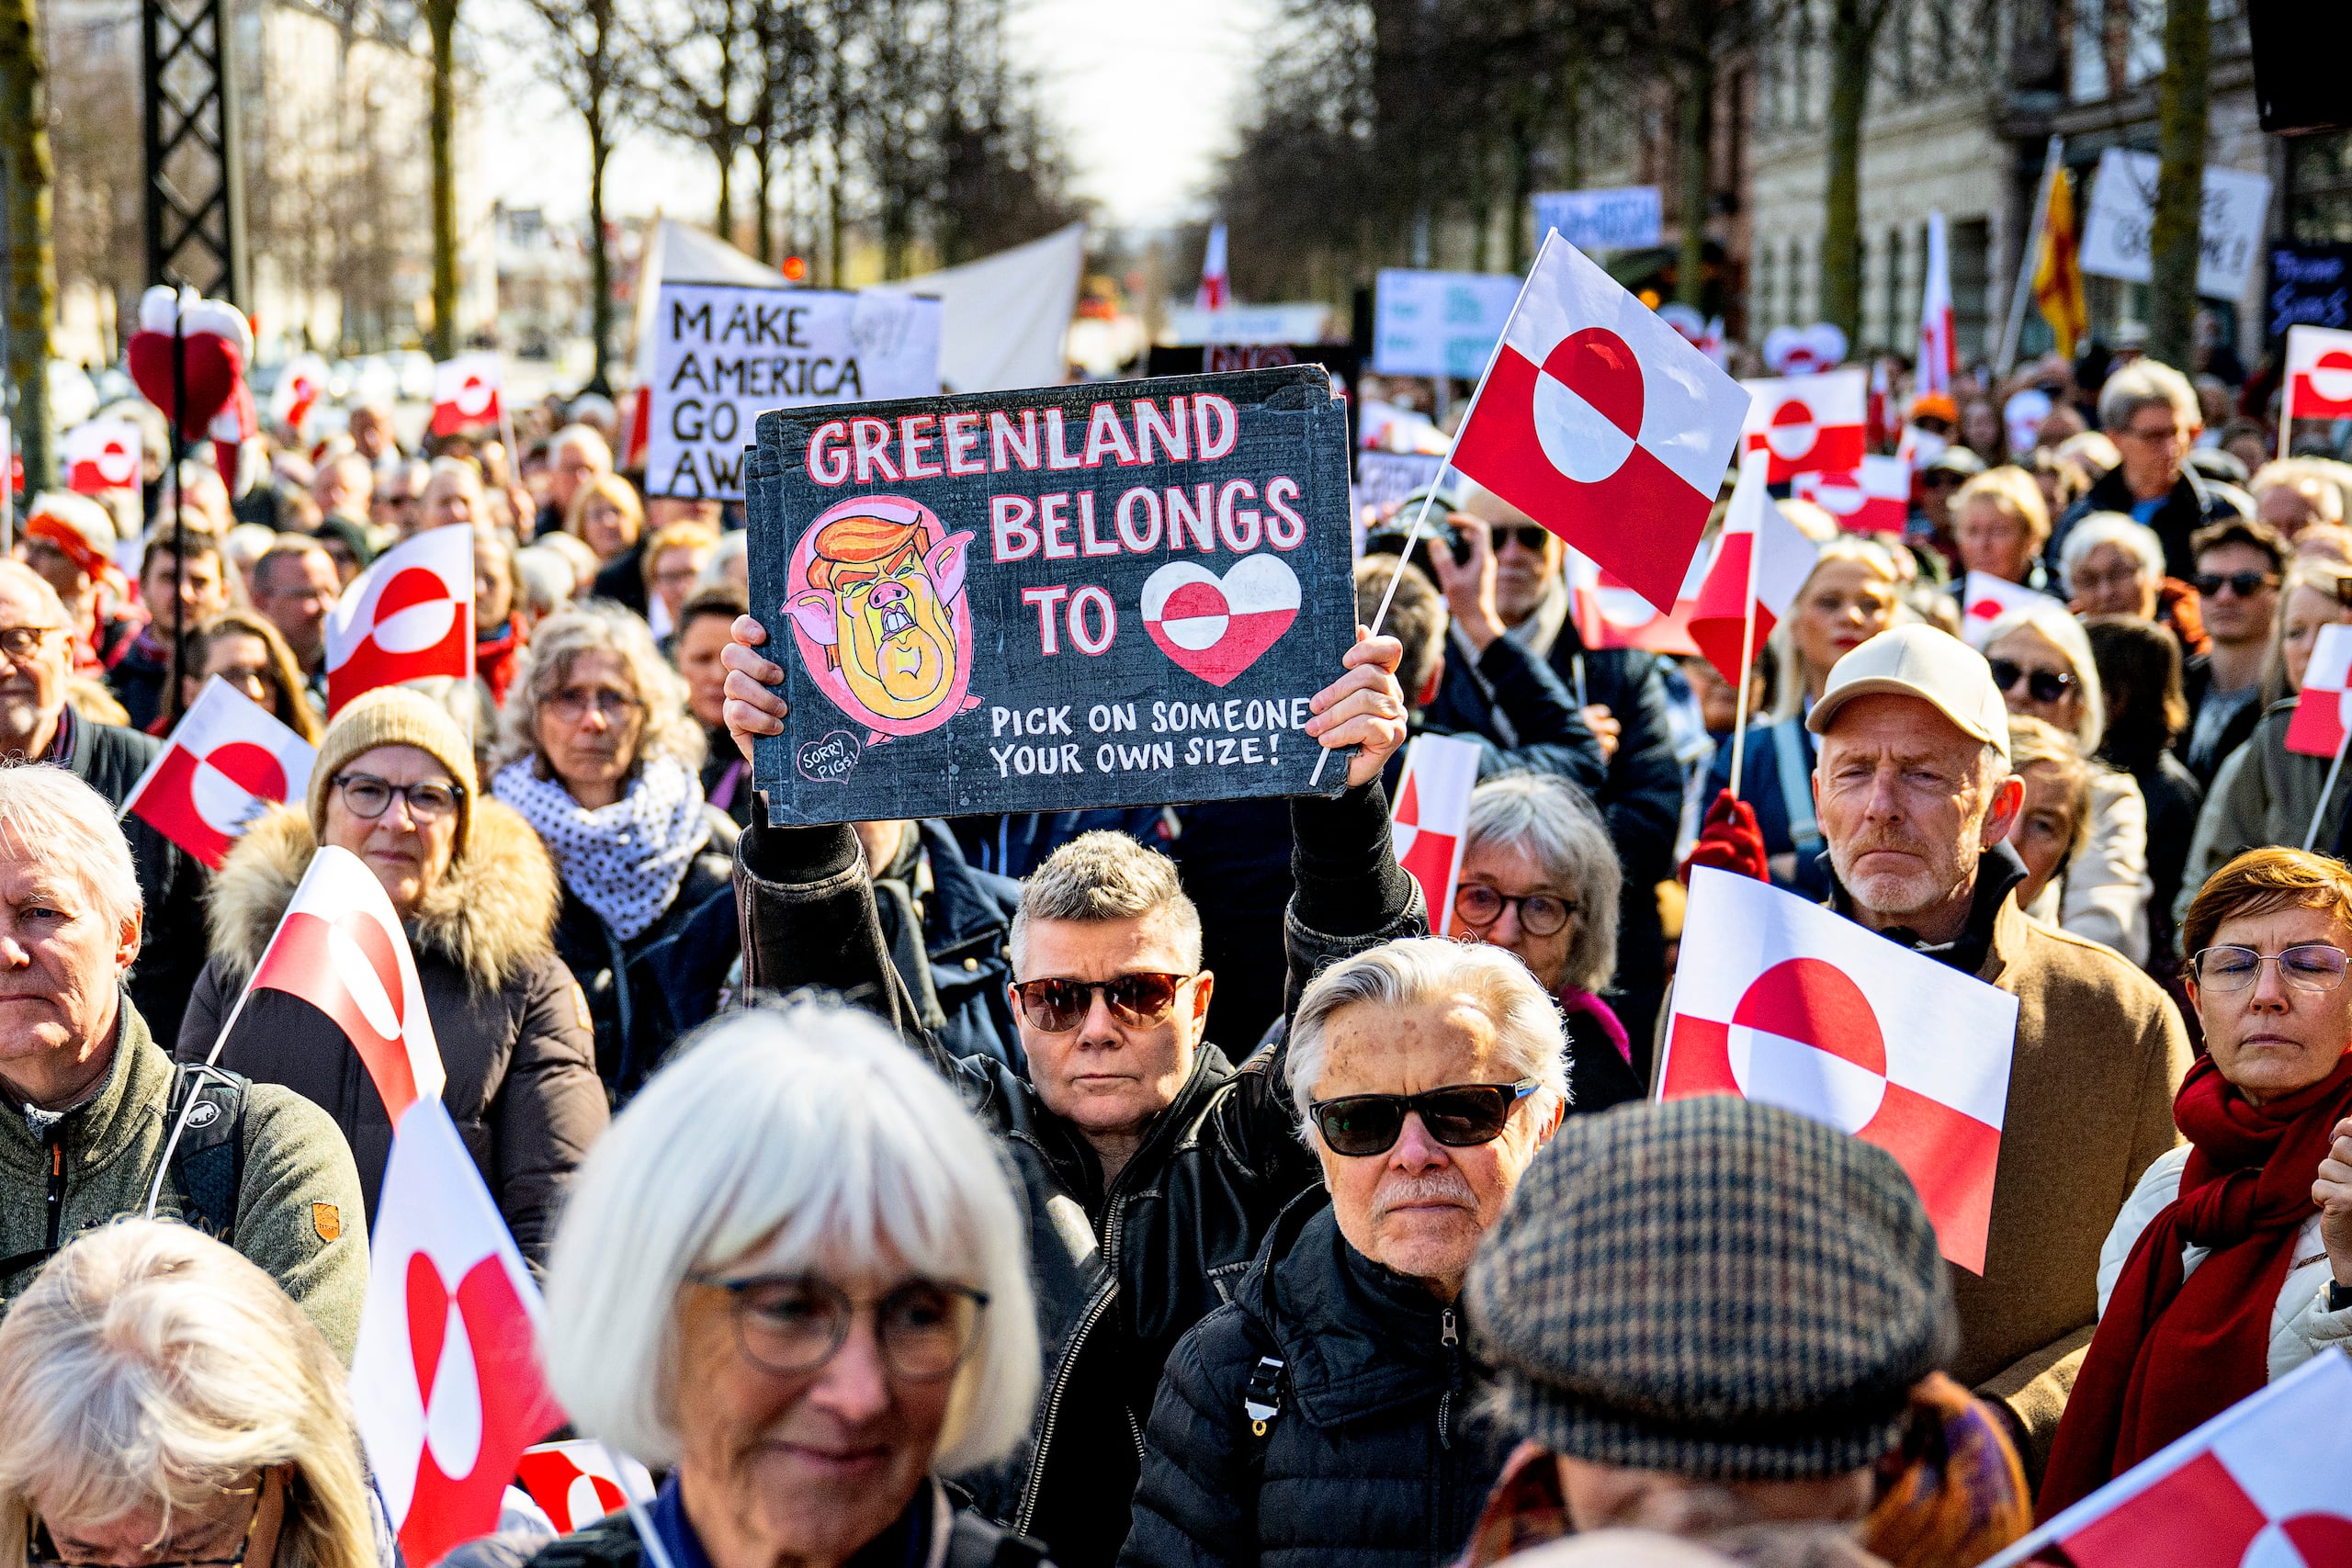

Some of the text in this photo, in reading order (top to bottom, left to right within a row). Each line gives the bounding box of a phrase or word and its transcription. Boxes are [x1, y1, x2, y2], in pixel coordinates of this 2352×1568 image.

[673, 300, 809, 347] MAKE
[669, 352, 862, 399] AMERICA
[673, 400, 738, 443] GO
[806, 393, 1238, 486] GREENLAND
[667, 449, 743, 497] AW
[989, 476, 1306, 563] BELONGS
[1022, 584, 1117, 656] TO
[991, 697, 1311, 737] PICK ON SOMEONE
[802, 739, 844, 769] SORRY
[989, 734, 1279, 778] YOUR OWN SIZE!
